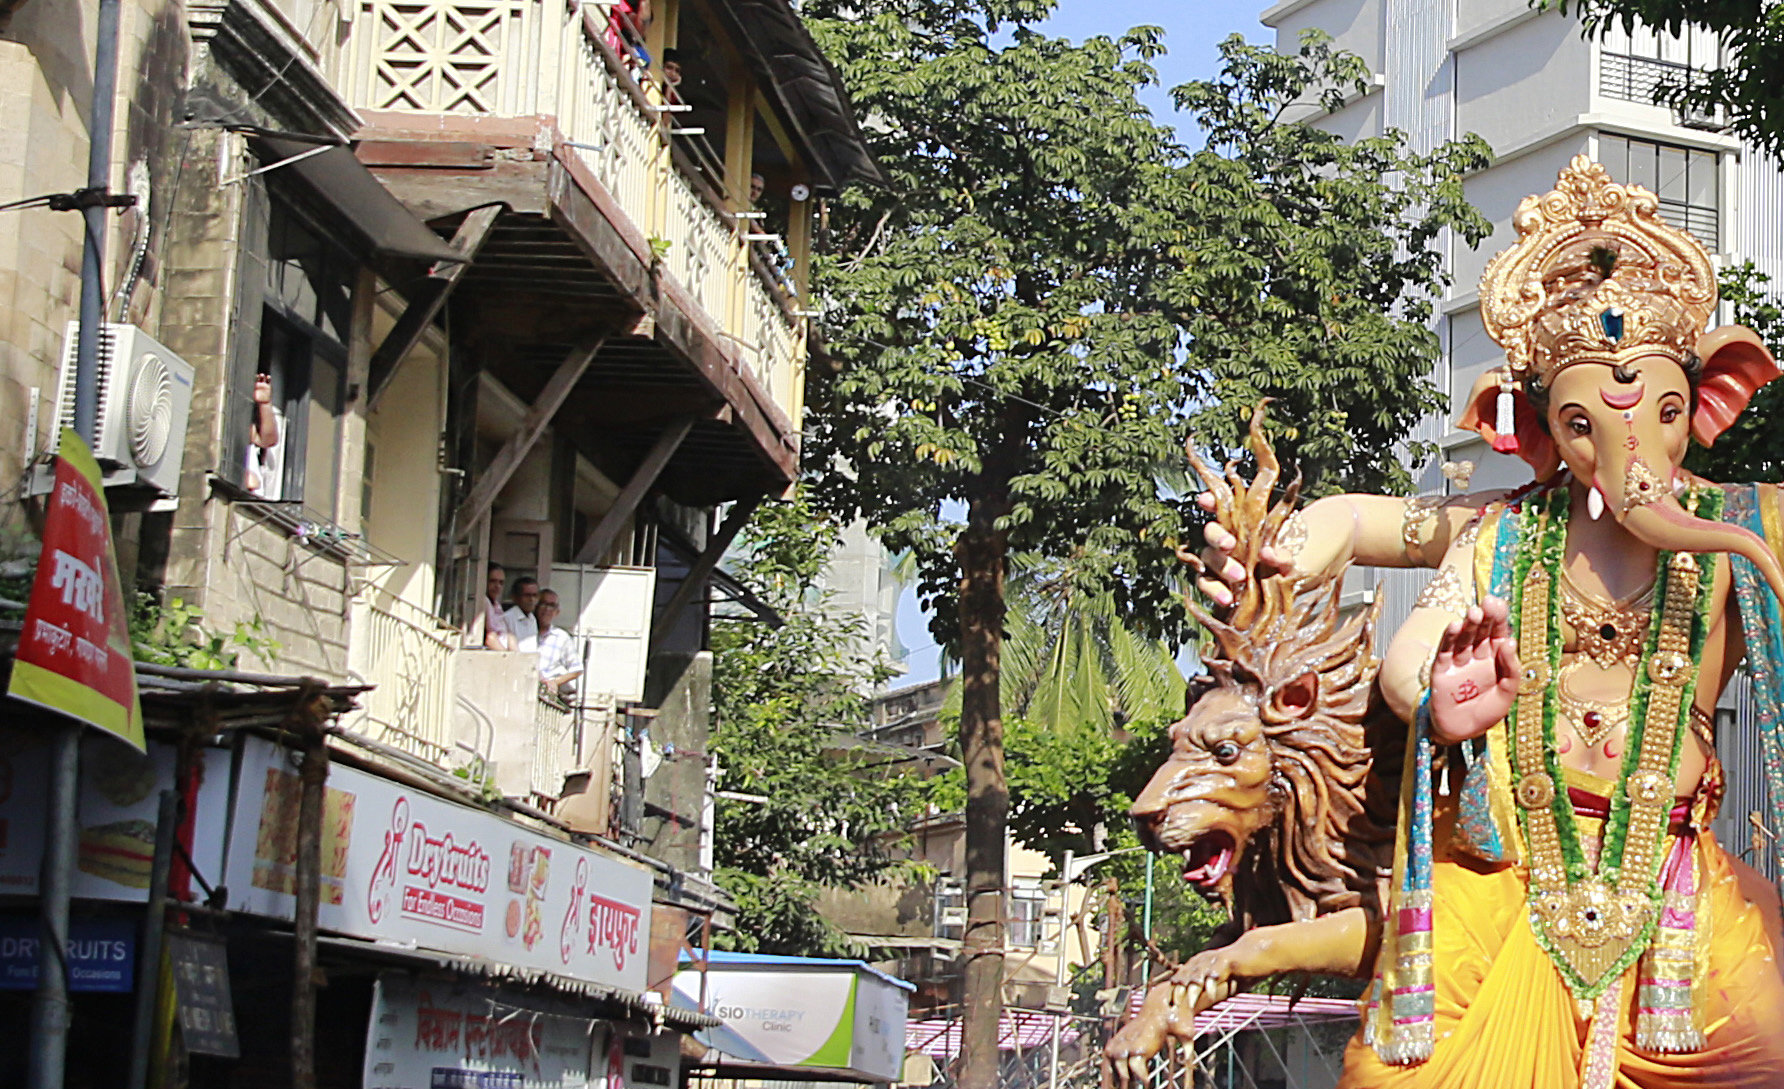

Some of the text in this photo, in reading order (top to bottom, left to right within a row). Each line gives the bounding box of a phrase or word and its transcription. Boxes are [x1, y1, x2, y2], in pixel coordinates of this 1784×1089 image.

[407, 822, 490, 893] Dryfruits
[417, 892, 445, 917] Endless
[446, 899, 483, 926] Occasions
[2, 937, 126, 961] DR RUITS
[762, 1021, 793, 1033] Clinic
